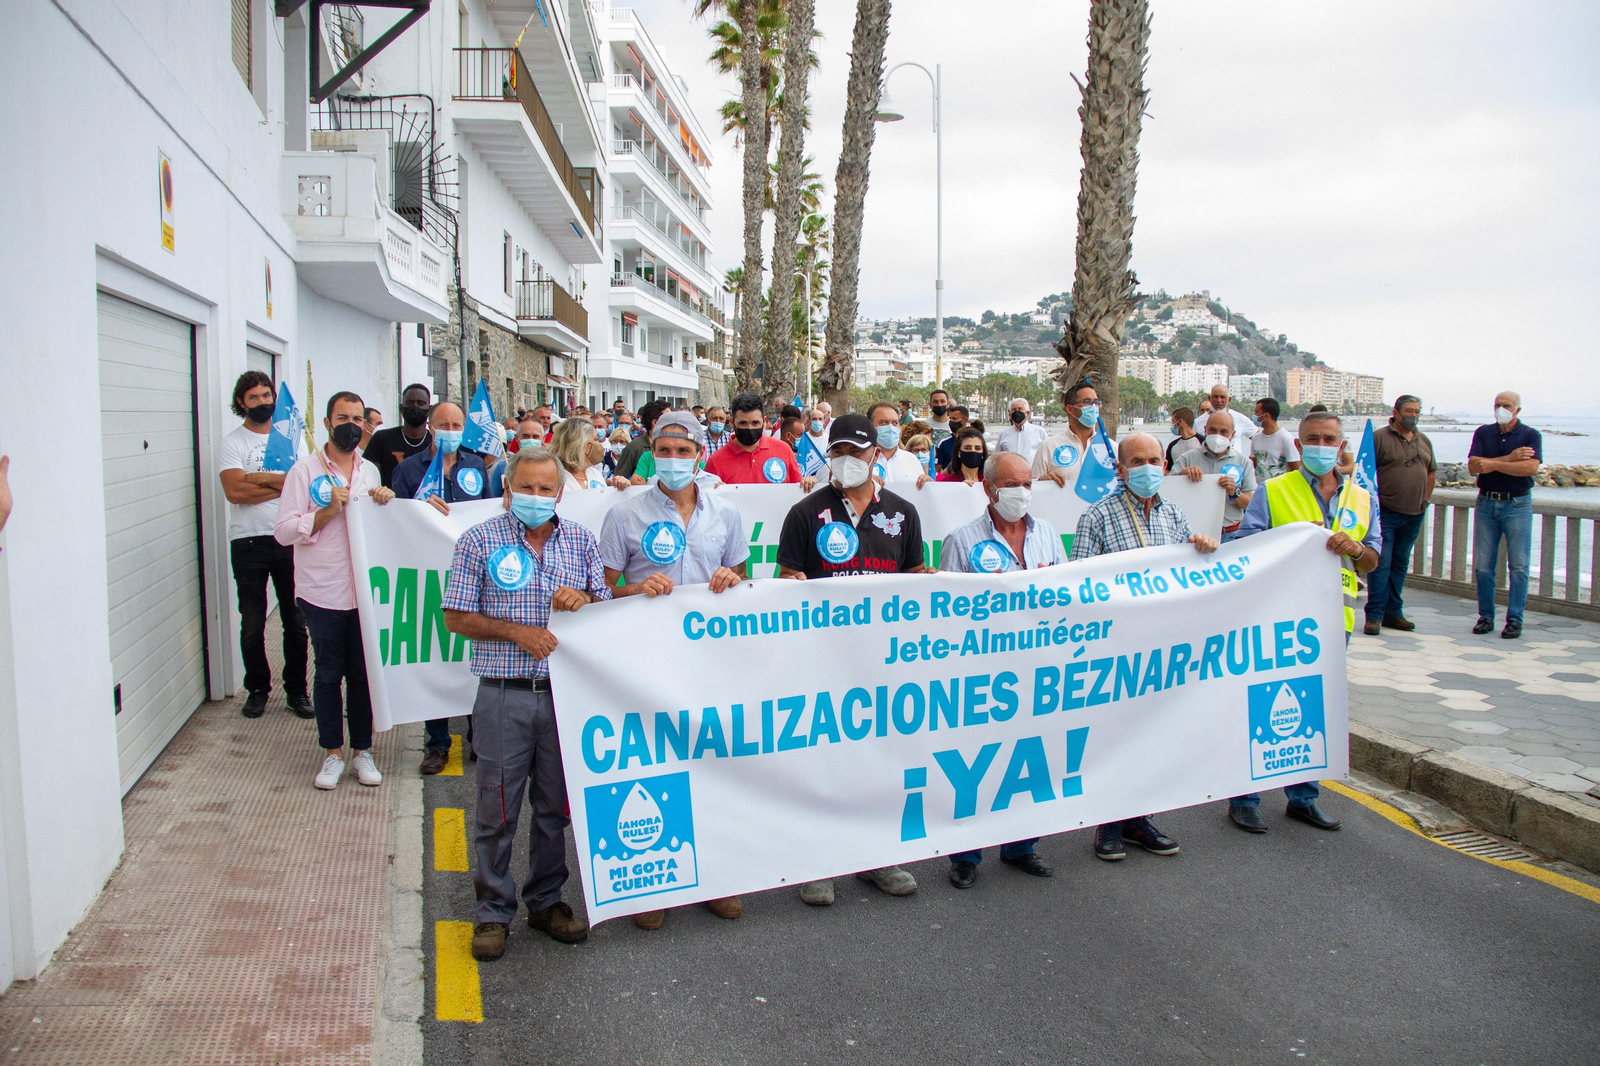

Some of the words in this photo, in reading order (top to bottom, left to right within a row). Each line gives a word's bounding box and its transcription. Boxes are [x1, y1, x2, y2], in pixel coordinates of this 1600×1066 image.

[864, 557, 897, 571] KONG
[683, 596, 871, 640] Comunidad
[881, 594, 920, 623] de
[930, 584, 1072, 621] Regantes
[1079, 577, 1110, 604] de
[1115, 568, 1169, 598] “Río
[1171, 555, 1250, 590] Verde”
[885, 617, 1113, 664] Jete-Almuñécar
[581, 671, 1019, 774] CANALIZACIONES
[1032, 617, 1321, 716] BÉZNAR-RULES
[1273, 707, 1298, 717] ¡AHORA
[1271, 716, 1301, 727] BÉZNAR!
[1263, 750, 1276, 760] MI
[1279, 743, 1311, 757] GOTA
[1265, 754, 1311, 771] CUENTA
[901, 726, 1090, 842] ¡YA!
[618, 816, 662, 830] ¡AHORA
[622, 825, 660, 838] RULES!
[609, 866, 628, 880] MI
[632, 858, 678, 875] GOTA
[612, 872, 678, 893] CUENTA
